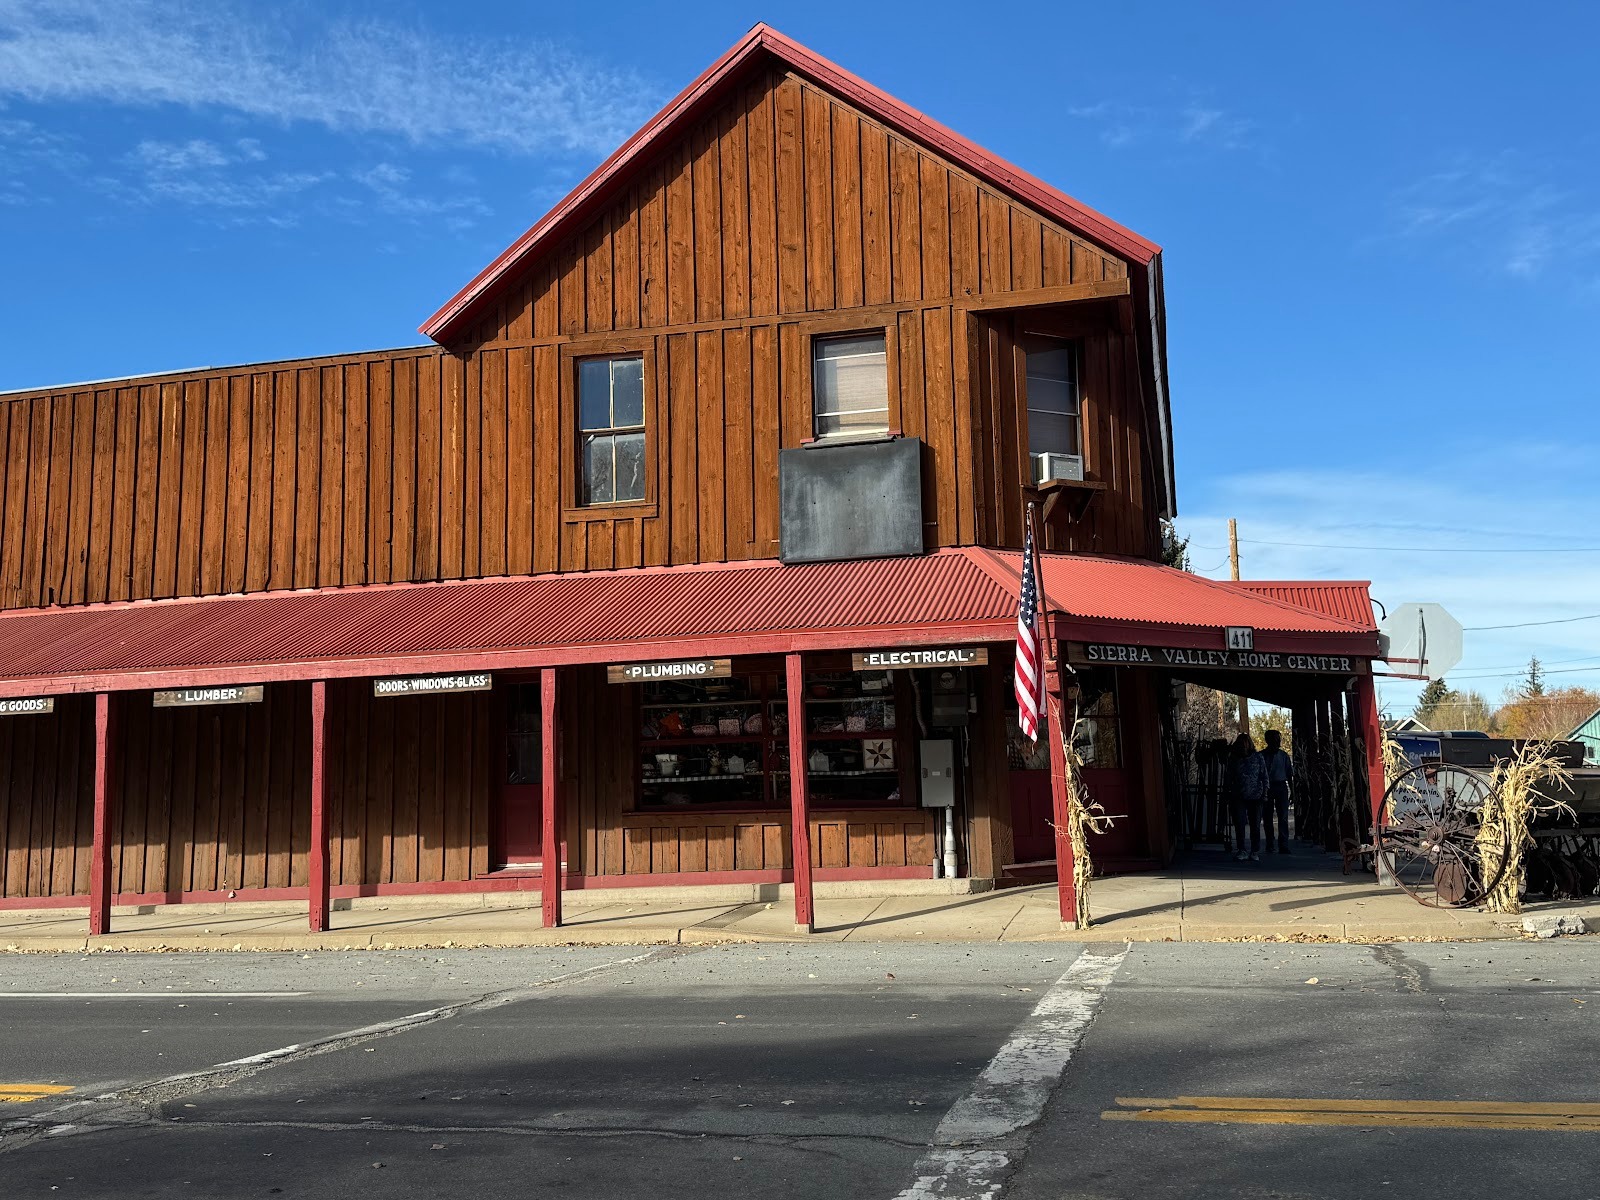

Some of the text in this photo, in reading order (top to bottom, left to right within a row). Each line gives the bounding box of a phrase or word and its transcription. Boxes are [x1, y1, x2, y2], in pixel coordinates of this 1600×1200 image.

[1231, 630, 1252, 648] 411
[869, 650, 969, 665] ELECTRICAL
[1088, 645, 1351, 671] SIERRA VALLEY HOME CENTER
[632, 663, 707, 678] PLUMBING
[185, 689, 237, 702] LUMBER
[9, 699, 44, 711] GOODS
